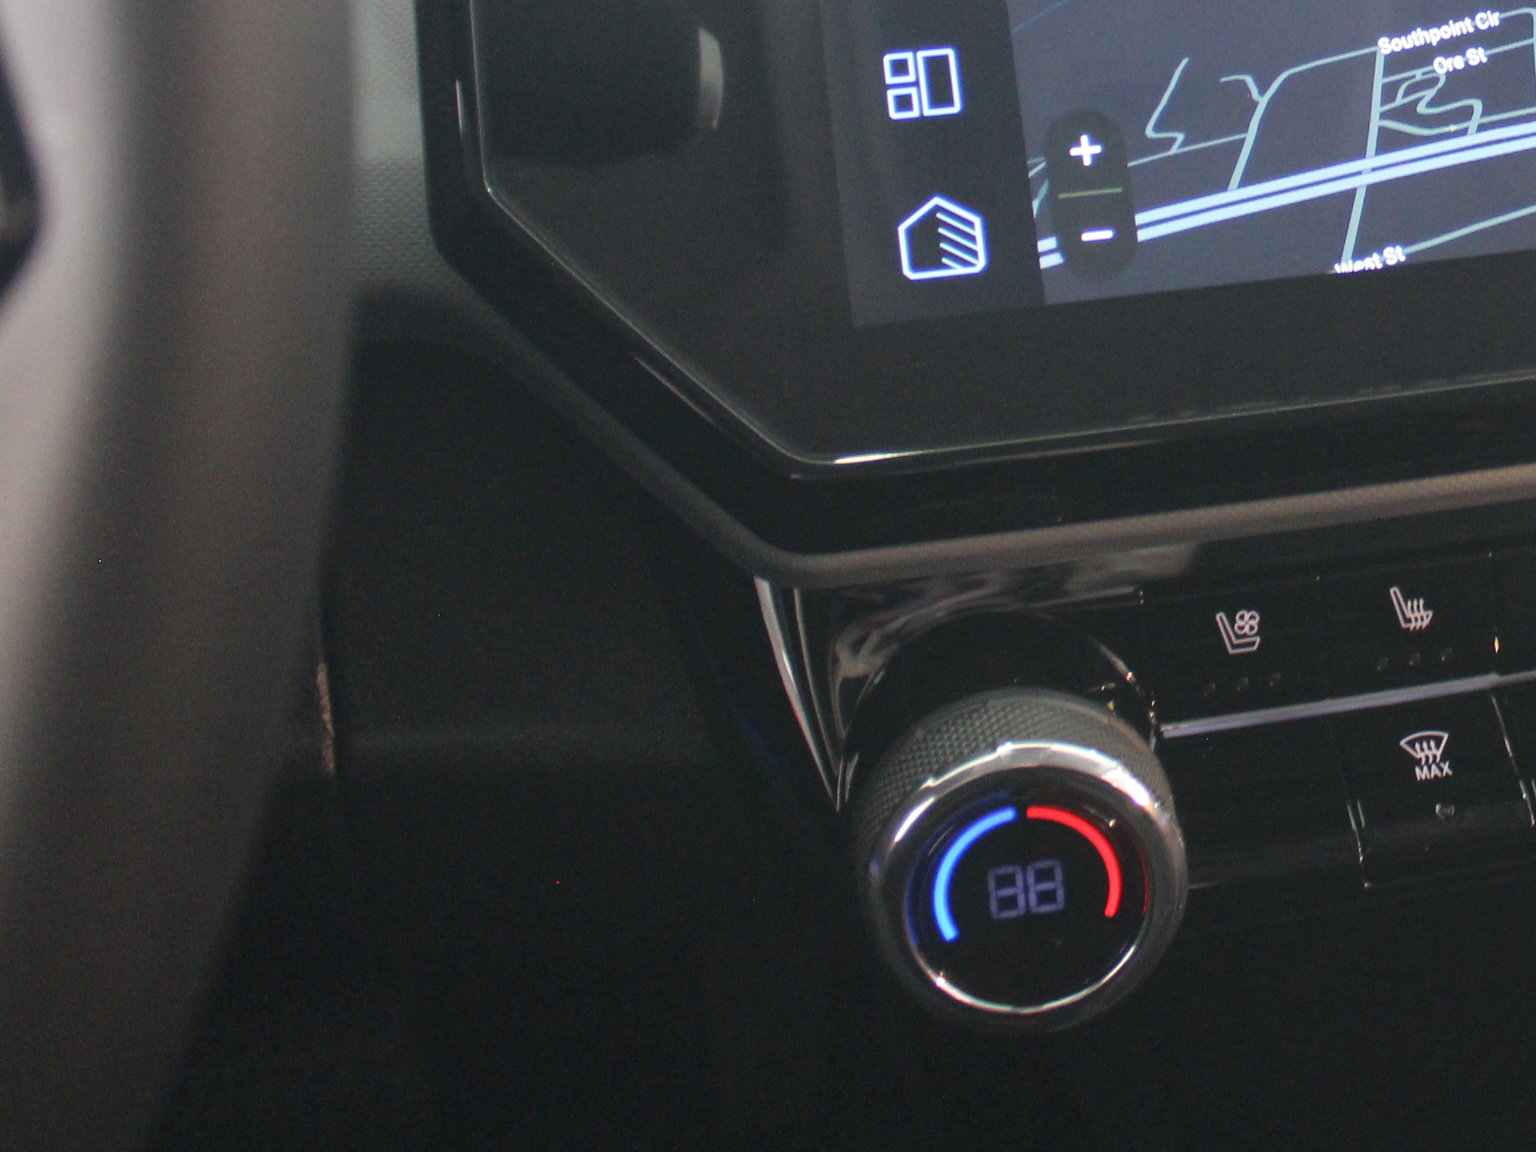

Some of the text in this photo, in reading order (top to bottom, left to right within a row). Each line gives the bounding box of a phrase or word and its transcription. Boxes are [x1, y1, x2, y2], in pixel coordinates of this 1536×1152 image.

[1377, 10, 1500, 55] Southpoint Cir
[1433, 46, 1488, 75] Ore St
[1383, 245, 1406, 266] St
[1414, 760, 1453, 782] MAX
